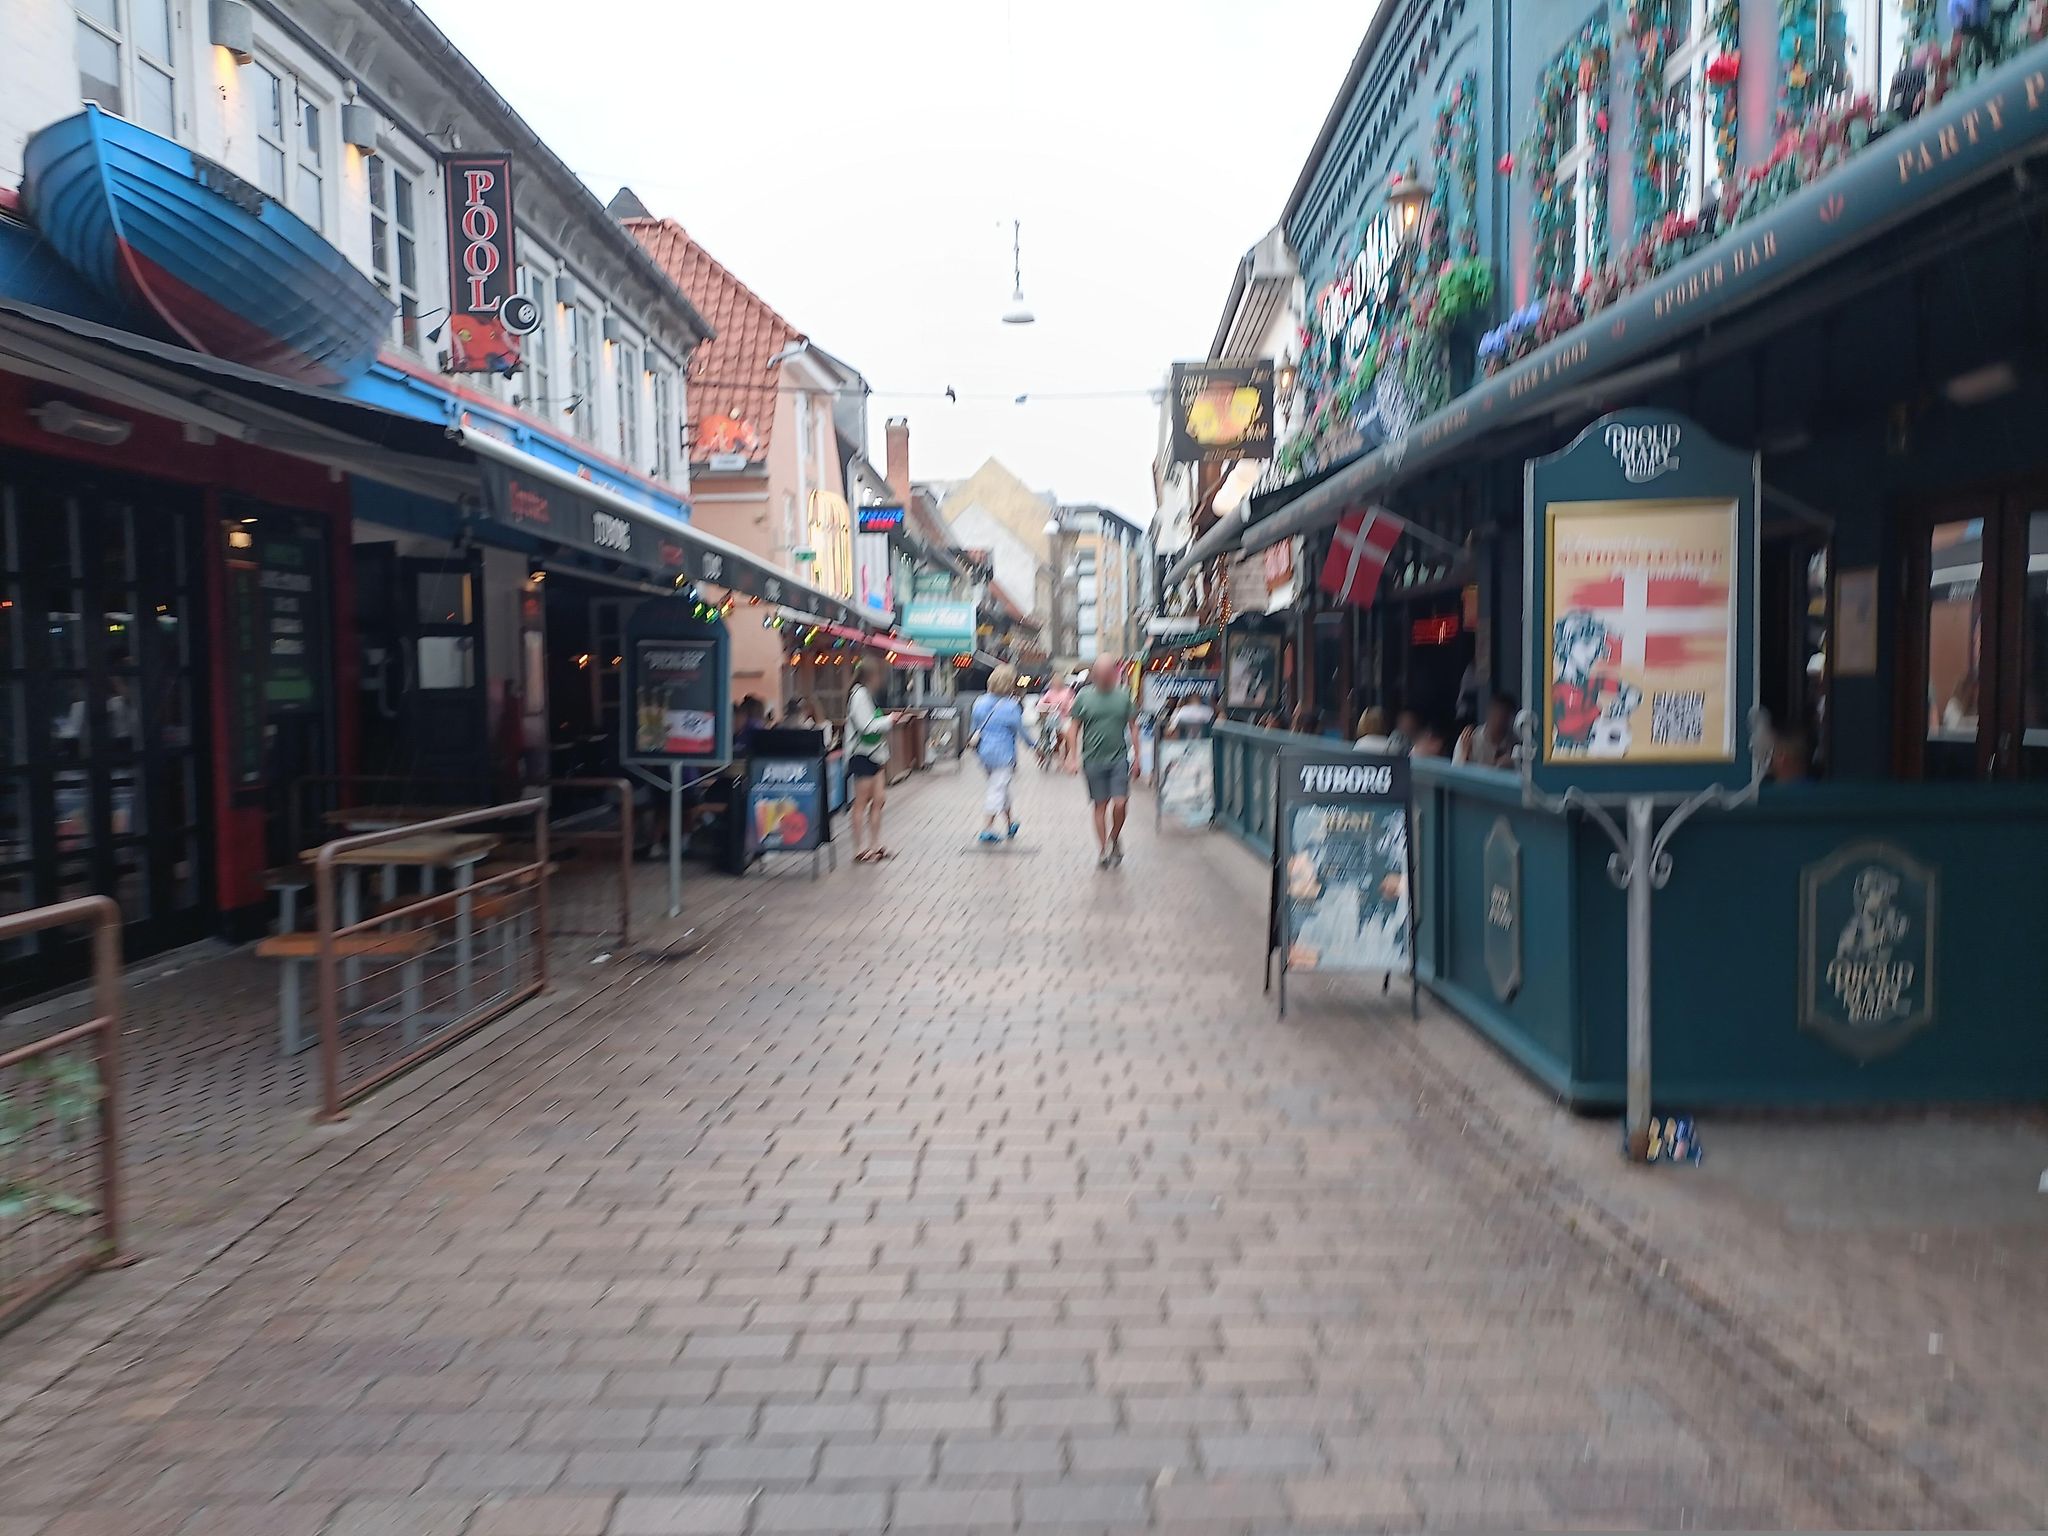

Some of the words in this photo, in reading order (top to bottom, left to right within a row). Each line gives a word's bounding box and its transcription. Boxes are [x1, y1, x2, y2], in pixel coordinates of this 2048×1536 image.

[1898, 94, 2004, 184] PARTY
[461, 170, 501, 312] POOL
[1654, 259, 1724, 320] SPORTS
[1734, 229, 1778, 276] BAR
[1604, 423, 1681, 459] PROUD
[1619, 442, 1671, 468] MARY
[1300, 764, 1393, 794] TUBORG
